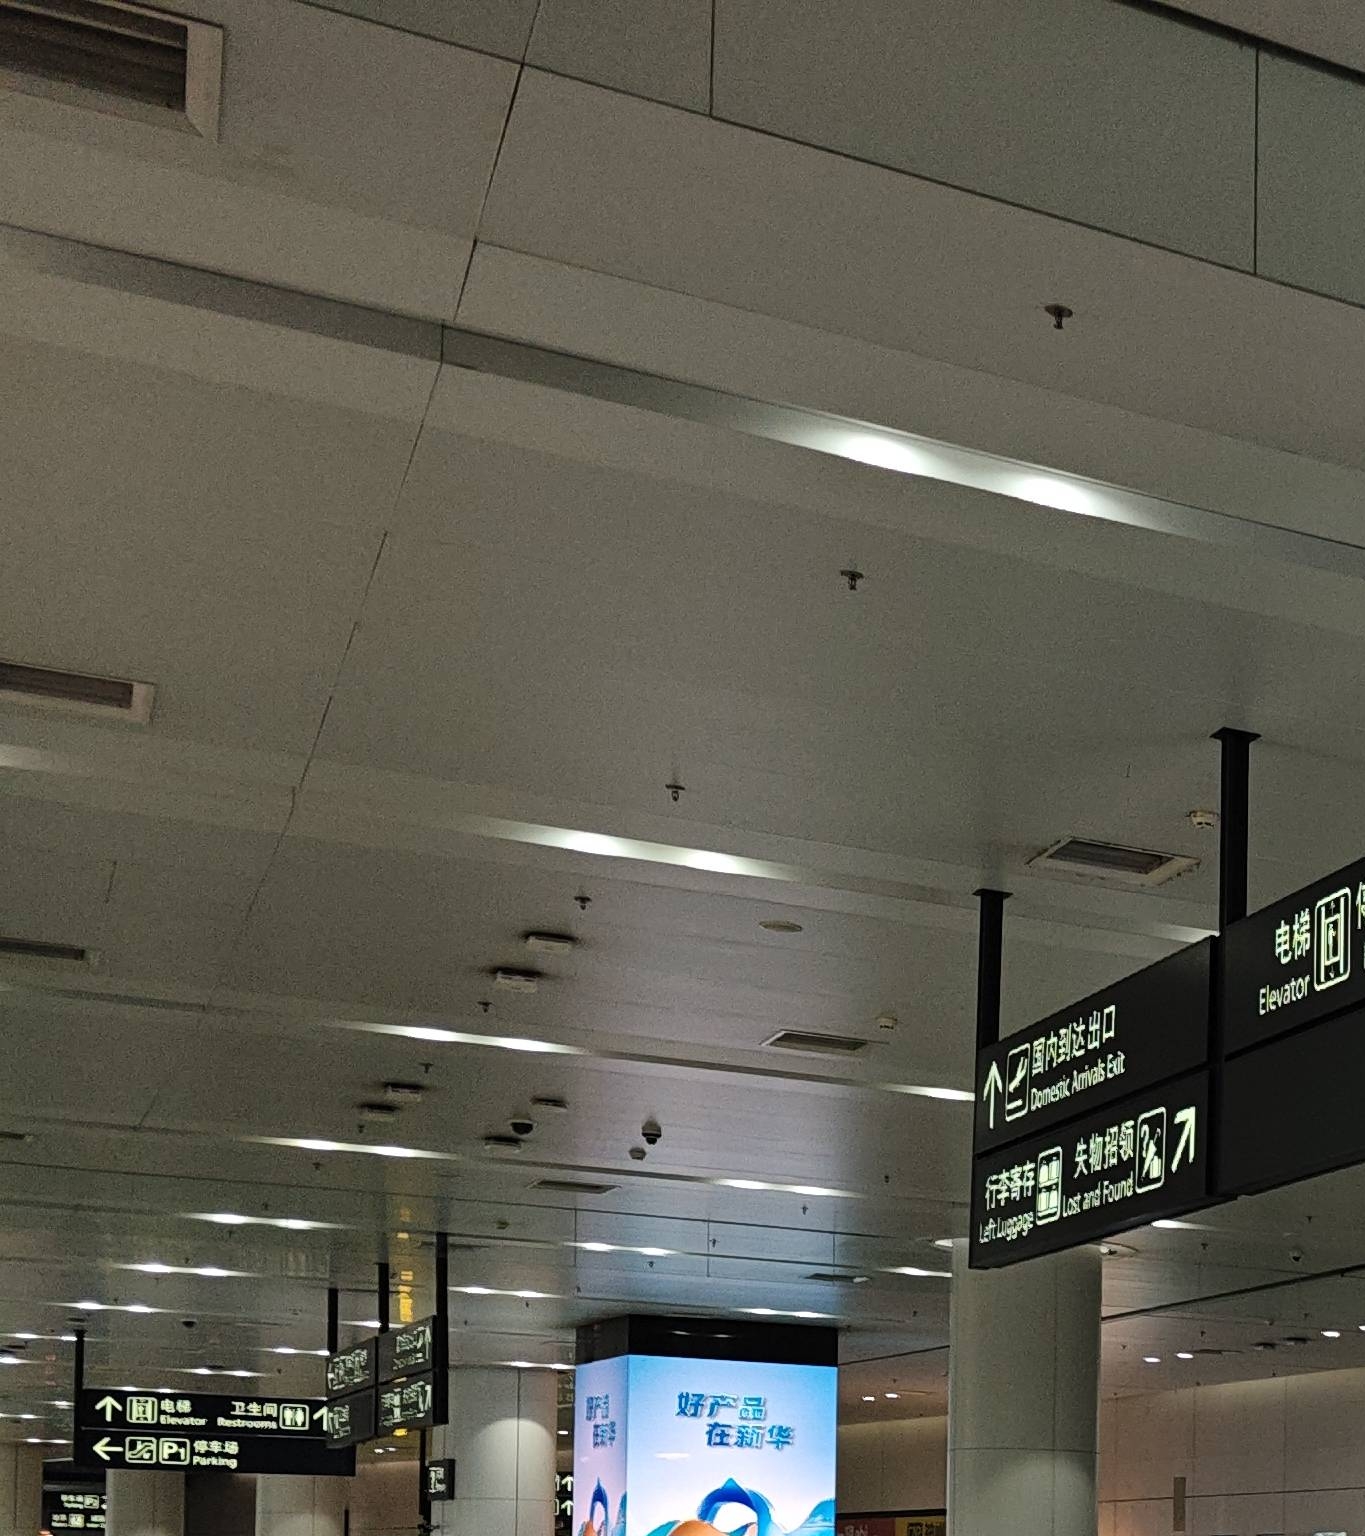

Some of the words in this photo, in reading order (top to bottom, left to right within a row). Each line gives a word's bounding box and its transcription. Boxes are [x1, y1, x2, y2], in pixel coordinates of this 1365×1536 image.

[1274, 908, 1310, 965] 电梯
[1259, 974, 1310, 1016] Elevator
[1031, 1005, 1116, 1077] 国内到达出口
[1031, 1074, 1070, 1111] Domestic
[1071, 1059, 1105, 1090] Arrivals
[1107, 1051, 1126, 1078] Exit
[1073, 1120, 1135, 1179] 失物招领
[985, 1160, 1036, 1211] 行李寄存
[1063, 1193, 1081, 1217] Lost
[1083, 1186, 1101, 1208] and
[1103, 1171, 1134, 1204] Found
[979, 1216, 996, 1243] Left
[997, 1211, 1034, 1242] Luggage
[160, 1399, 192, 1414] 电梯
[160, 1415, 207, 1426] Elevator
[230, 1401, 278, 1418] 卫生间
[674, 1391, 767, 1420] 好产品
[217, 1417, 278, 1429] Restrooms
[705, 1421, 795, 1450] 在新华
[193, 1440, 239, 1455] 停车场
[193, 1456, 238, 1469] Parking
